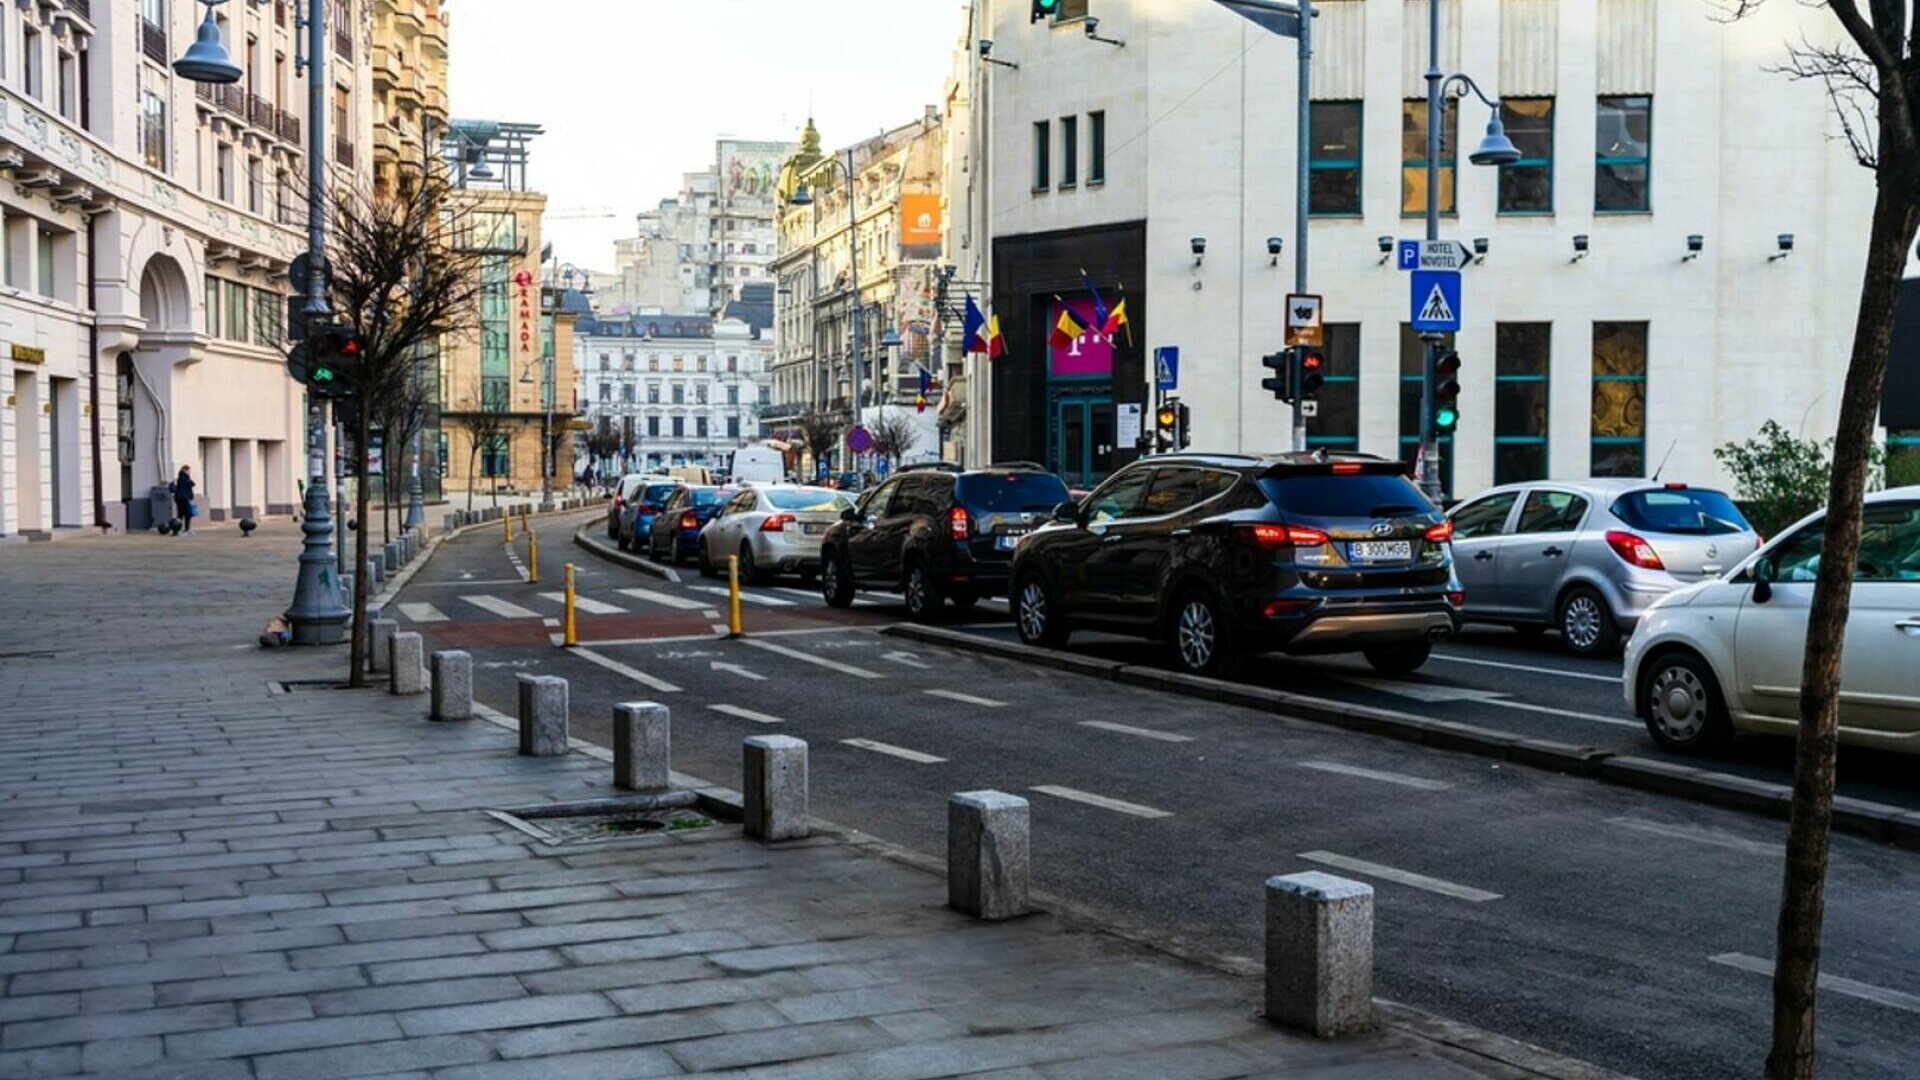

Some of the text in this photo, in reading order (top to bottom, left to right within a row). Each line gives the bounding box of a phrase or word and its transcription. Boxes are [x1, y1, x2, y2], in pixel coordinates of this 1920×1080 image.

[1427, 243, 1453, 253] HOTEL
[1404, 249, 1415, 265] P
[1421, 256, 1456, 267] NOVOTEL
[520, 288, 529, 352] RAMADA
[1355, 543, 1363, 556] B
